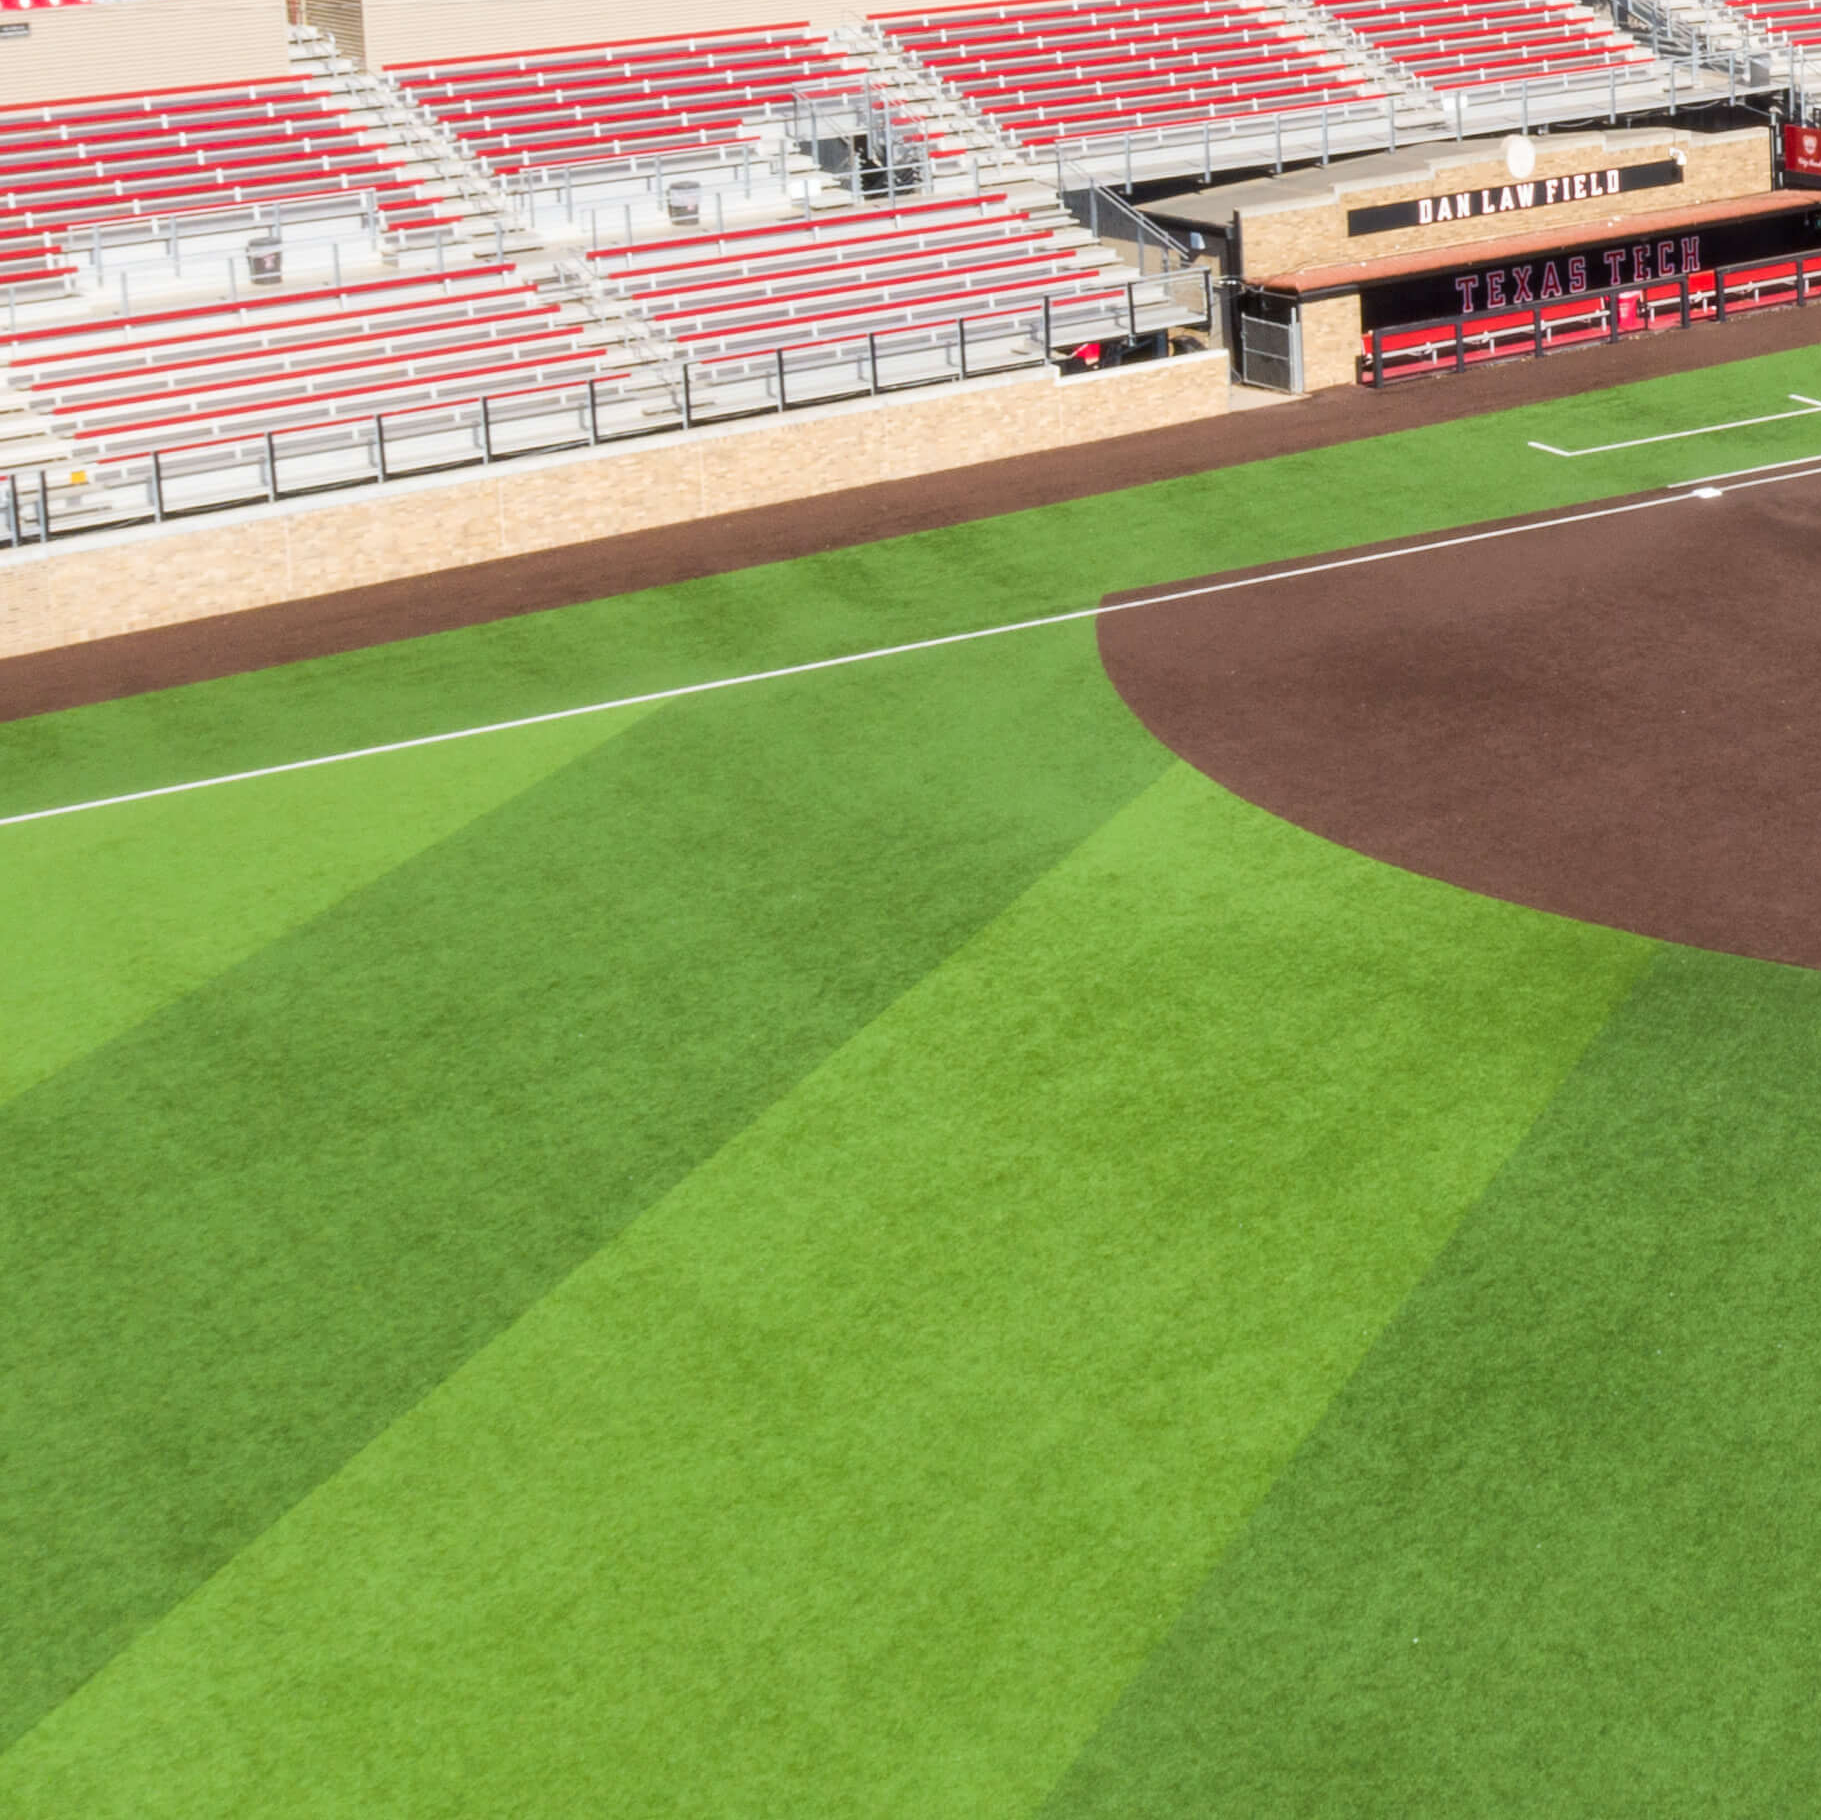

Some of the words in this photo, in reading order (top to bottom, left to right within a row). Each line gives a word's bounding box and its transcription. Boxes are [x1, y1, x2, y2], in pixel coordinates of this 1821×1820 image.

[1418, 192, 1470, 224] DAN
[1481, 182, 1535, 214] LAW
[1545, 169, 1620, 204] FIELD
[1455, 255, 1586, 313] TEXAS
[1603, 235, 1701, 285] TECH
